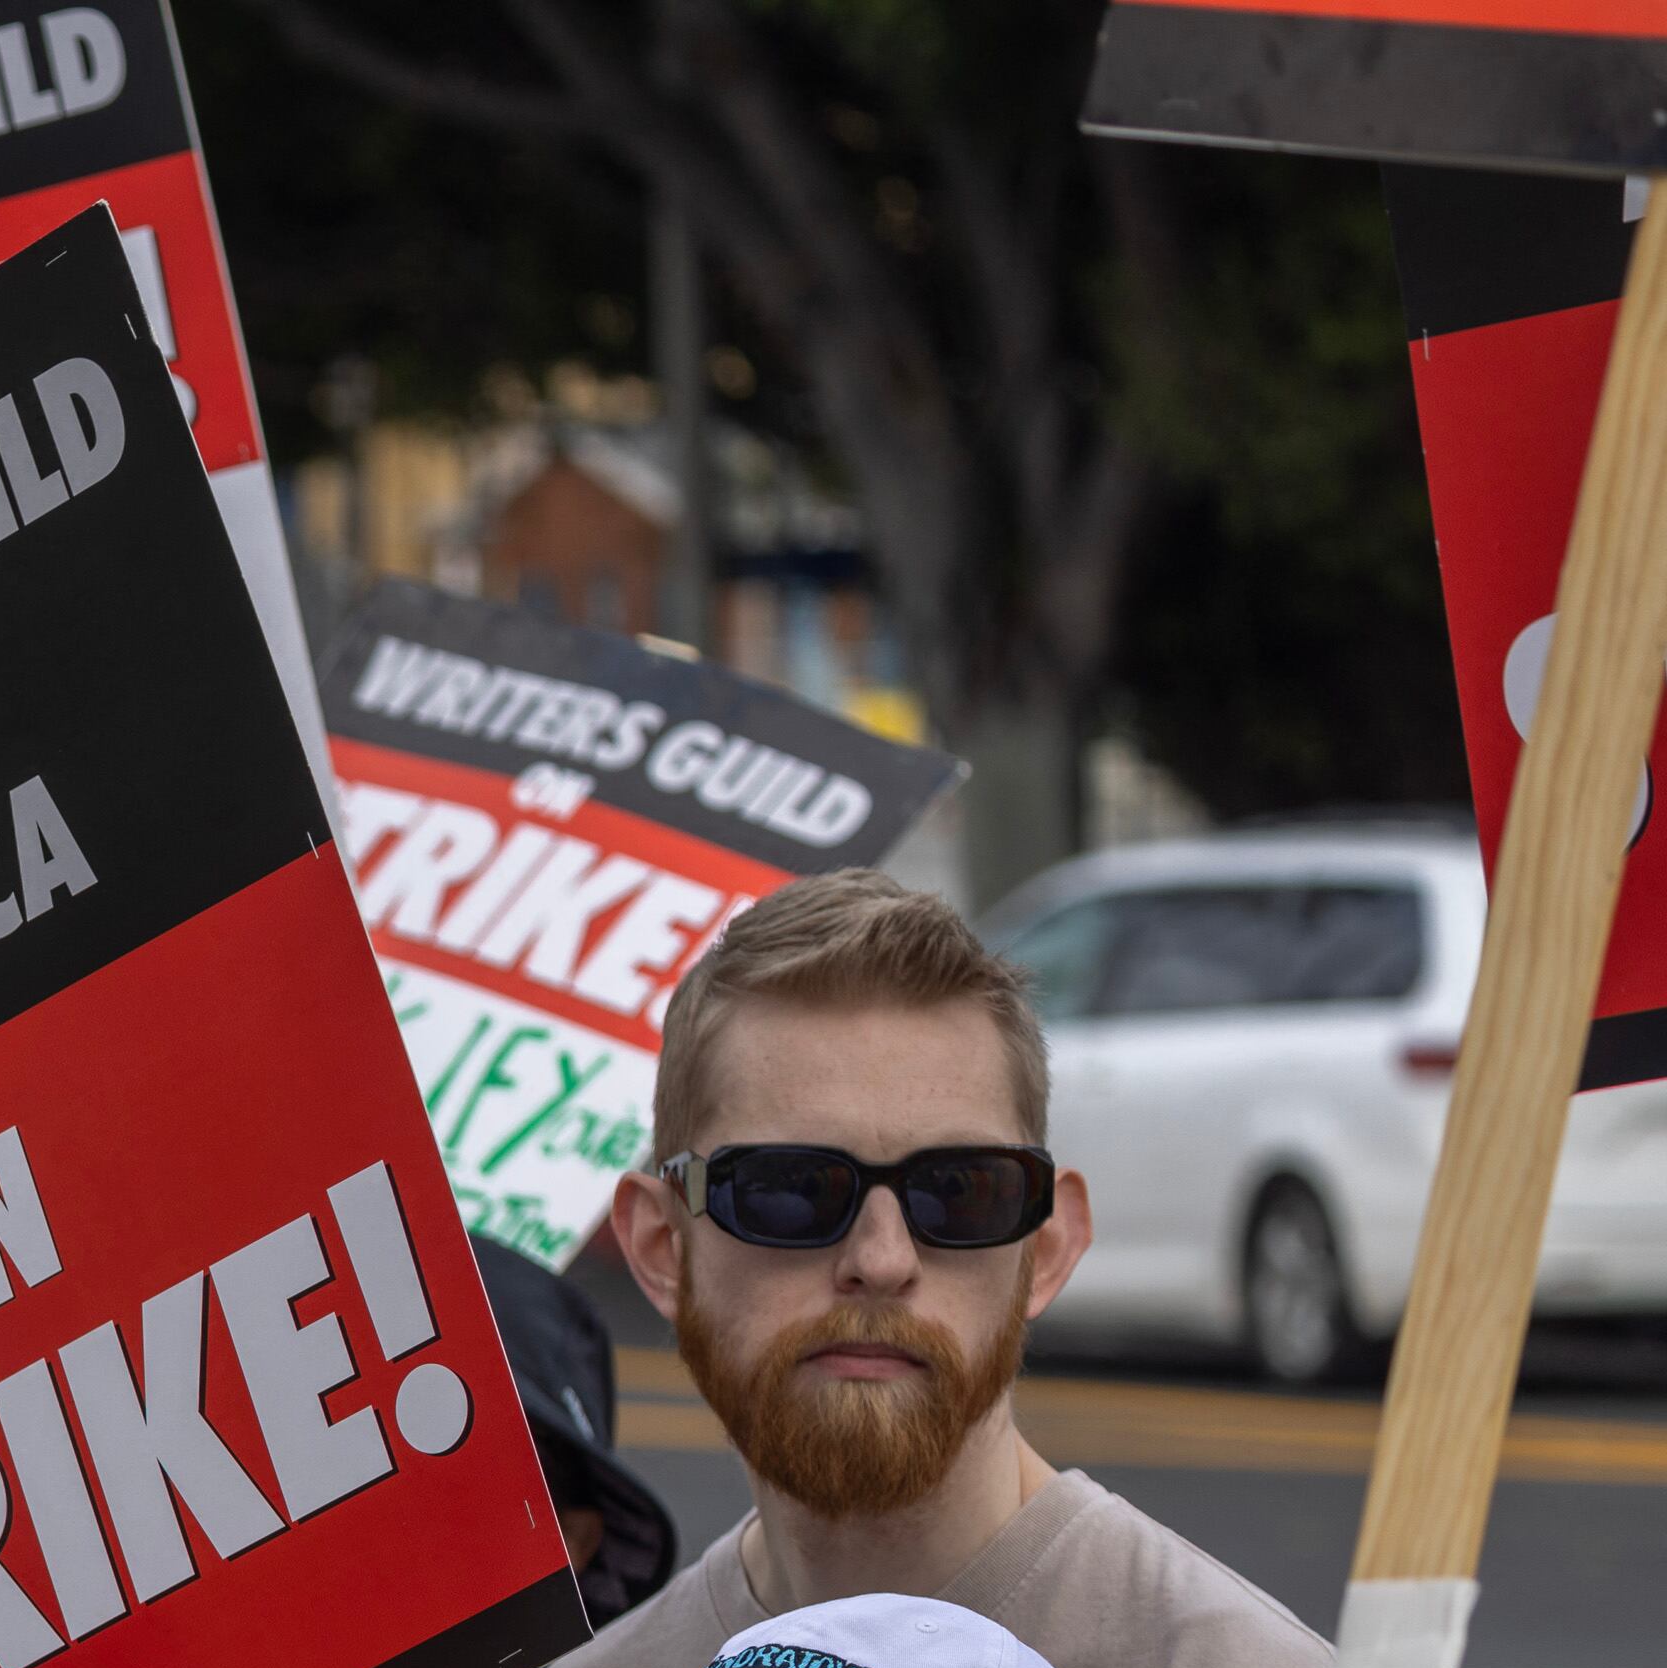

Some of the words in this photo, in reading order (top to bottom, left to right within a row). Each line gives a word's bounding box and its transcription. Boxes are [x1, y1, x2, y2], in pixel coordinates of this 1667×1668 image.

[355, 634, 667, 770] WRITERS
[645, 719, 873, 848] GUILD
[510, 762, 595, 819] ON
[339, 775, 755, 1030] TRIKE
